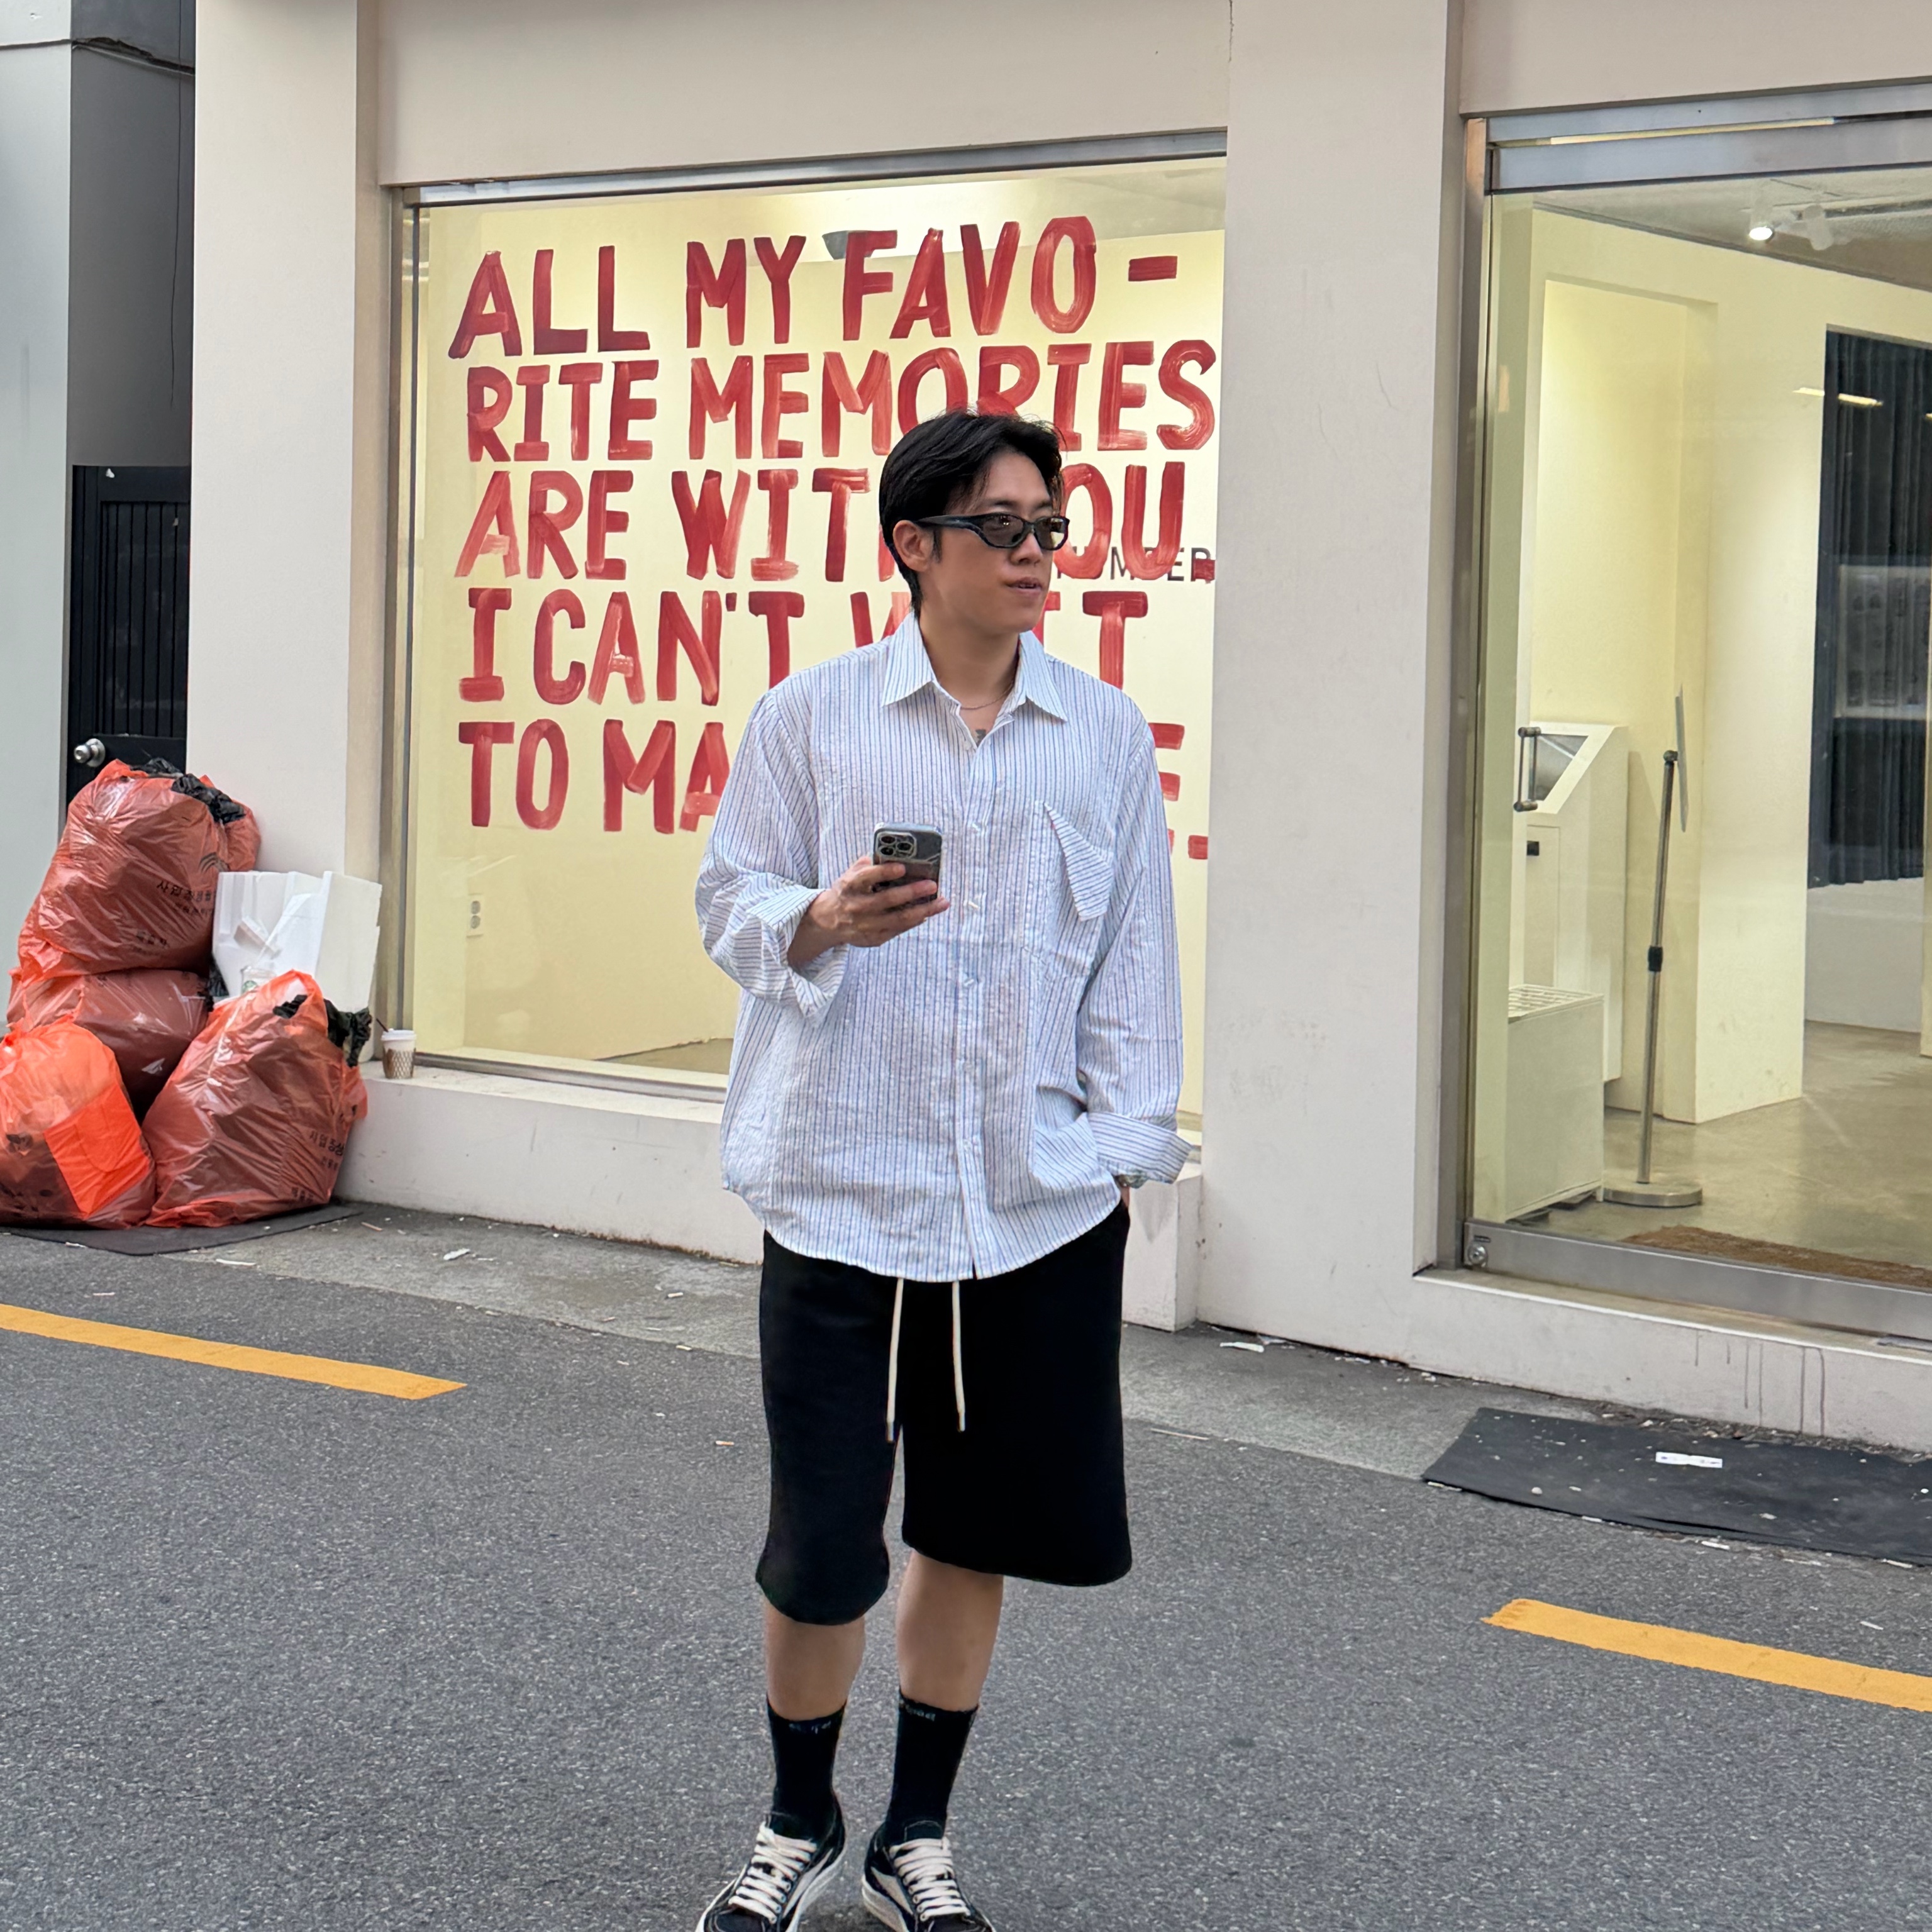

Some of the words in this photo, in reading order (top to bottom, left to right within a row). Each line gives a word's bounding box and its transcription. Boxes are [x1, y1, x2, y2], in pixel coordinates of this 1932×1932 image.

[448, 245, 650, 358] ALL
[686, 235, 806, 348] MY
[467, 360, 659, 462] RITE
[689, 340, 1216, 459] MEMORIES
[454, 470, 634, 580] ARE
[459, 587, 512, 703] I
[533, 589, 805, 706] CAN'T
[458, 718, 570, 831] TO
